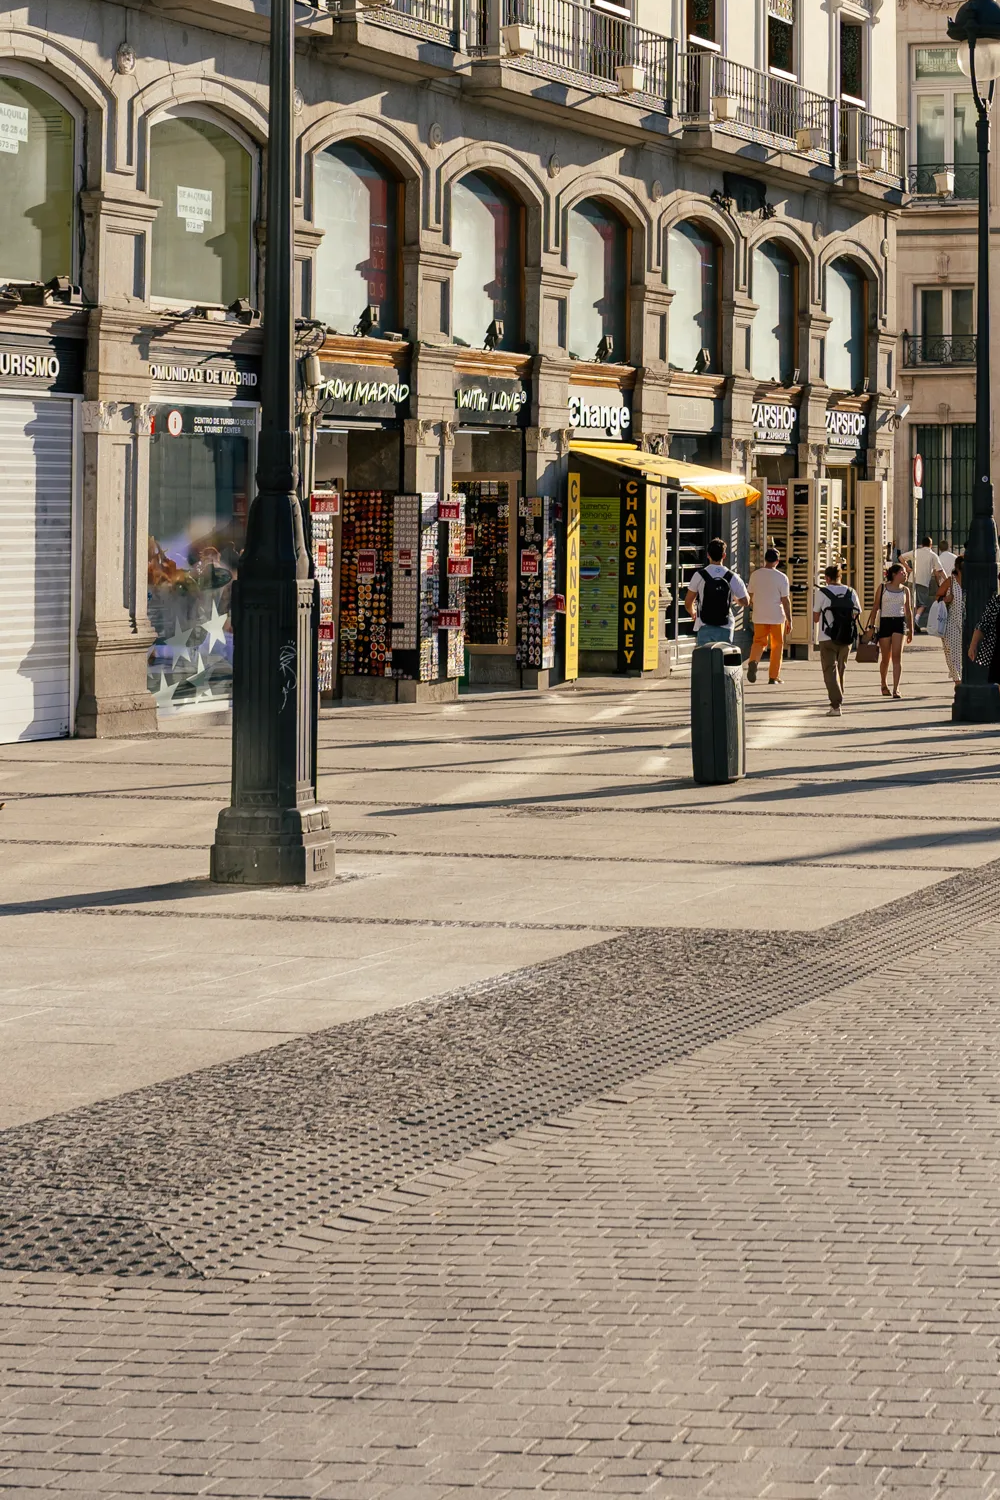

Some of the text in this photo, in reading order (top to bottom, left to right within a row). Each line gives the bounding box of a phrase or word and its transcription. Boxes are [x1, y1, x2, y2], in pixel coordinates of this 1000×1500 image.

[206, 369, 219, 384] DE
[221, 370, 258, 387] MADRID
[355, 380, 410, 405] MADRID
[457, 388, 488, 412] WITH
[193, 416, 213, 425] CENTRO
[213, 417, 220, 425] DE
[568, 396, 630, 435] Change
[752, 403, 797, 429] ZAPSHOP
[825, 411, 867, 435] ZAPSHOP
[193, 425, 204, 433] SOL
[569, 479, 578, 647] CHANGE
[623, 480, 638, 664] CHANGE MONEY
[648, 485, 658, 640] CHANGE
